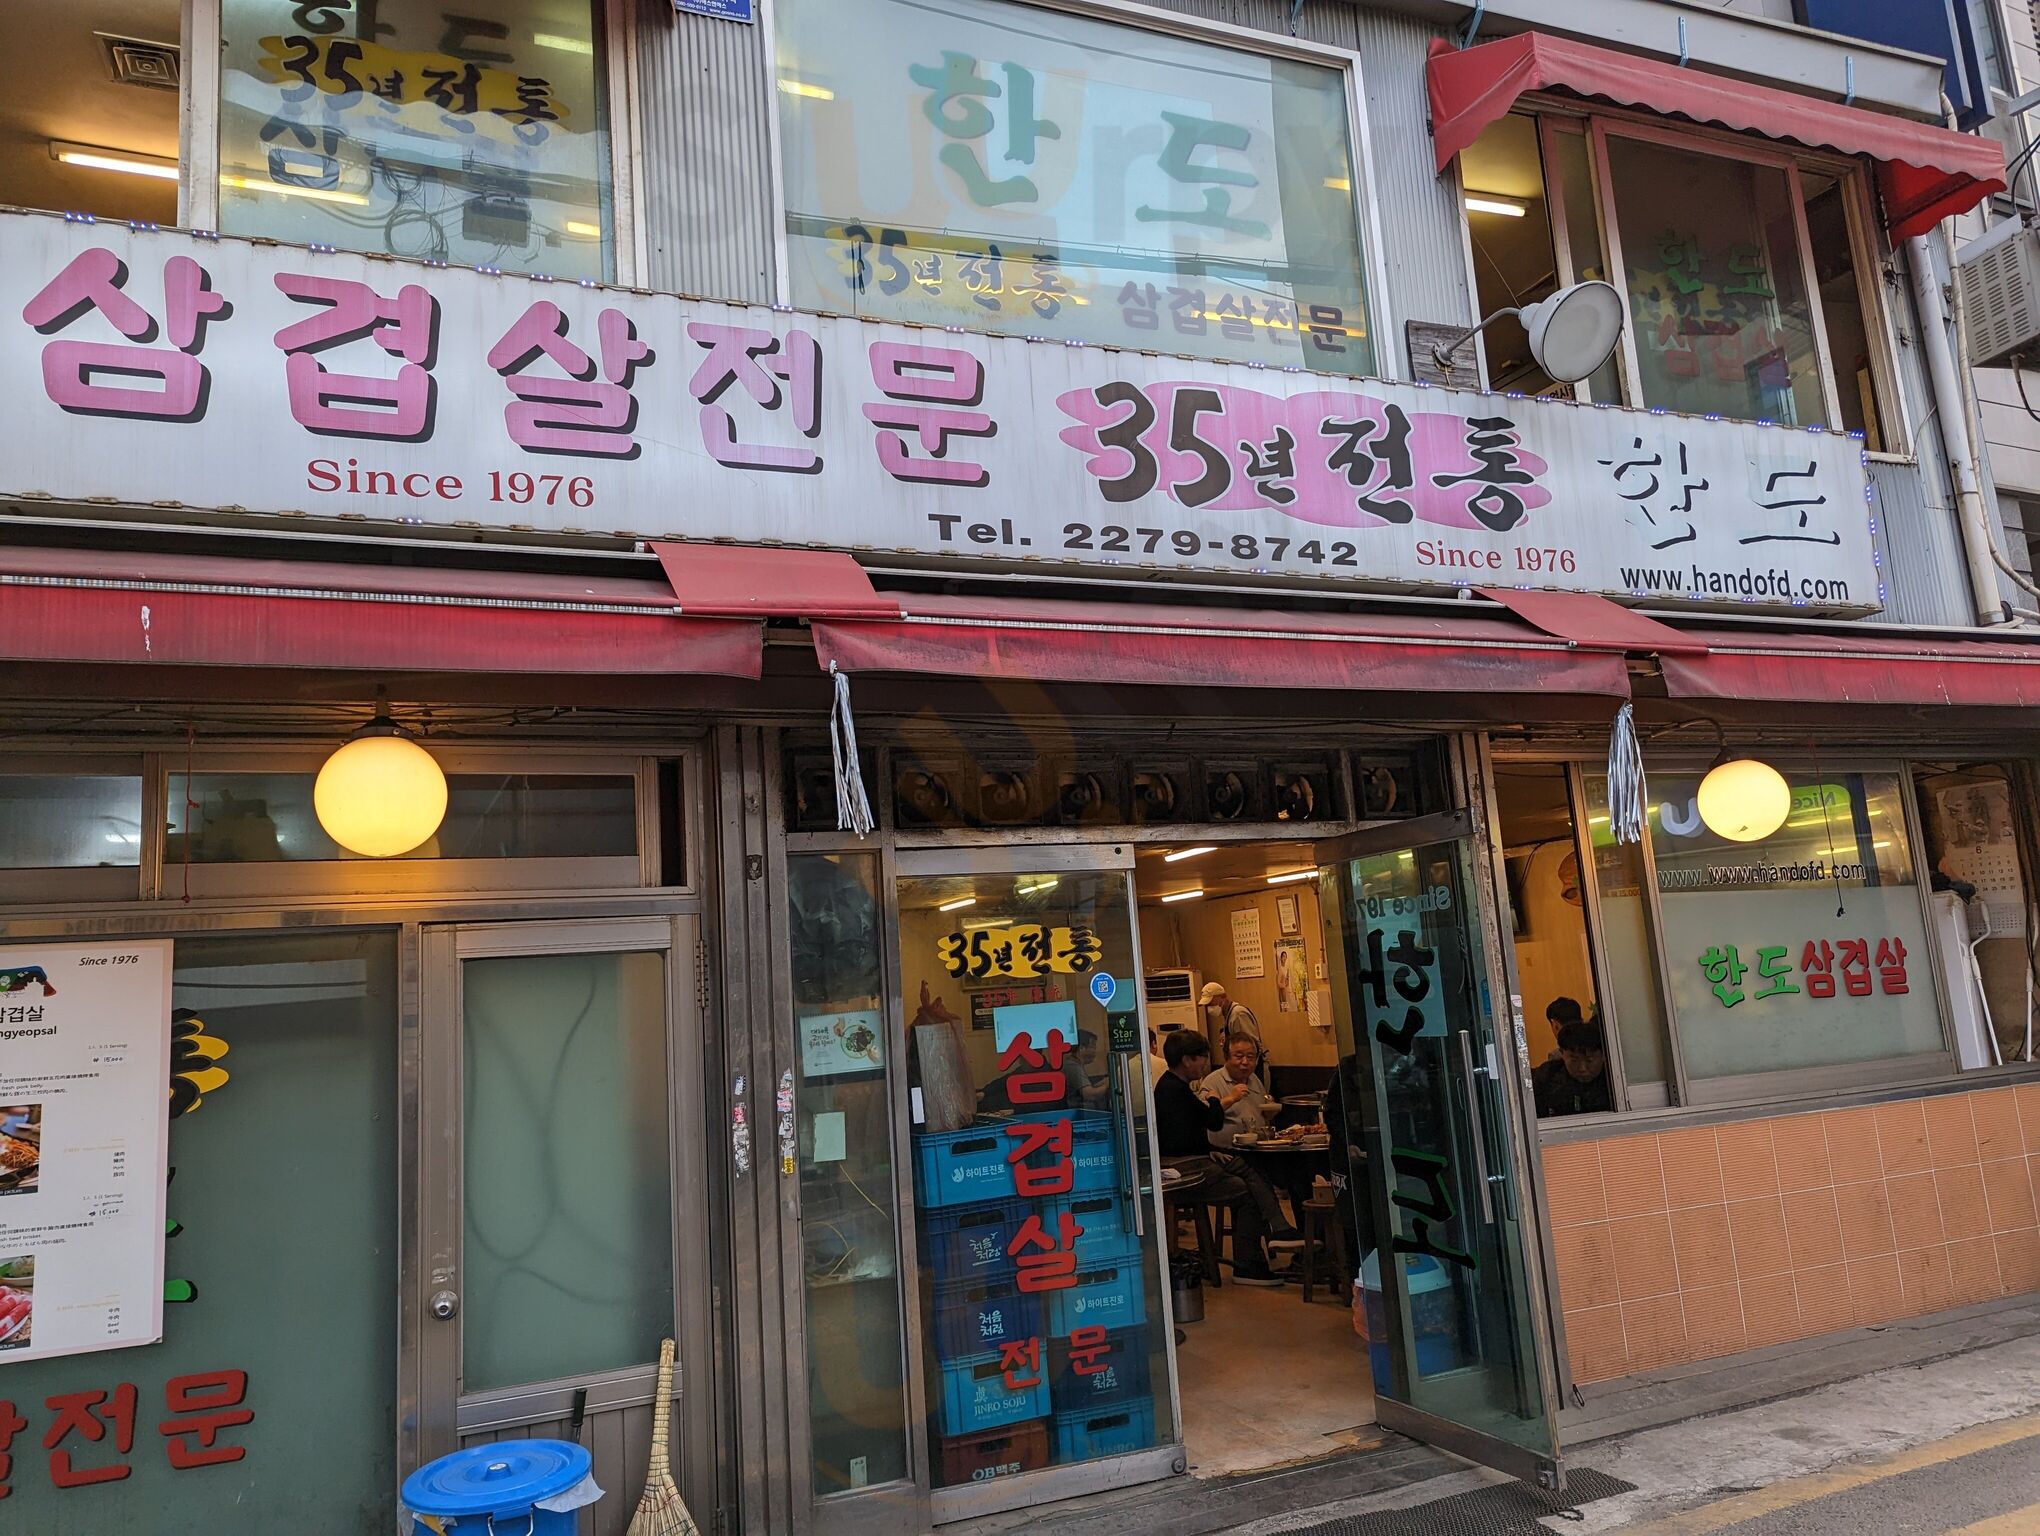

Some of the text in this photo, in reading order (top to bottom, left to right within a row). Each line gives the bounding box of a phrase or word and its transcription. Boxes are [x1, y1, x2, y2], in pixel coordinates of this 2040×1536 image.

[1117, 280, 1347, 355] 삼겹살전문
[23, 247, 998, 490] 삼겹살전문
[1093, 380, 1535, 532] 35년전통
[306, 459, 596, 508] Since 1976
[927, 513, 1358, 568] Tel. 2279-8742
[1415, 540, 1577, 575] Since 1976
[1620, 565, 1850, 602] www.handofd.com
[79, 955, 139, 966] Since 1976
[948, 925, 1094, 979] 35년전통
[1698, 936, 1911, 1008] 한도 삼겹살
[1113, 1028, 1134, 1039] Star
[966, 1164, 1006, 1178] 하이트진로
[999, 1028, 1084, 1294] 삼겹살
[1078, 1155, 1115, 1168] 하이트진로
[1087, 1294, 1125, 1309] 하이트진로
[999, 1325, 1112, 1390] 전문
[1002, 1395, 1027, 1410] SOJU
[972, 1461, 1022, 1481] OB맥주
